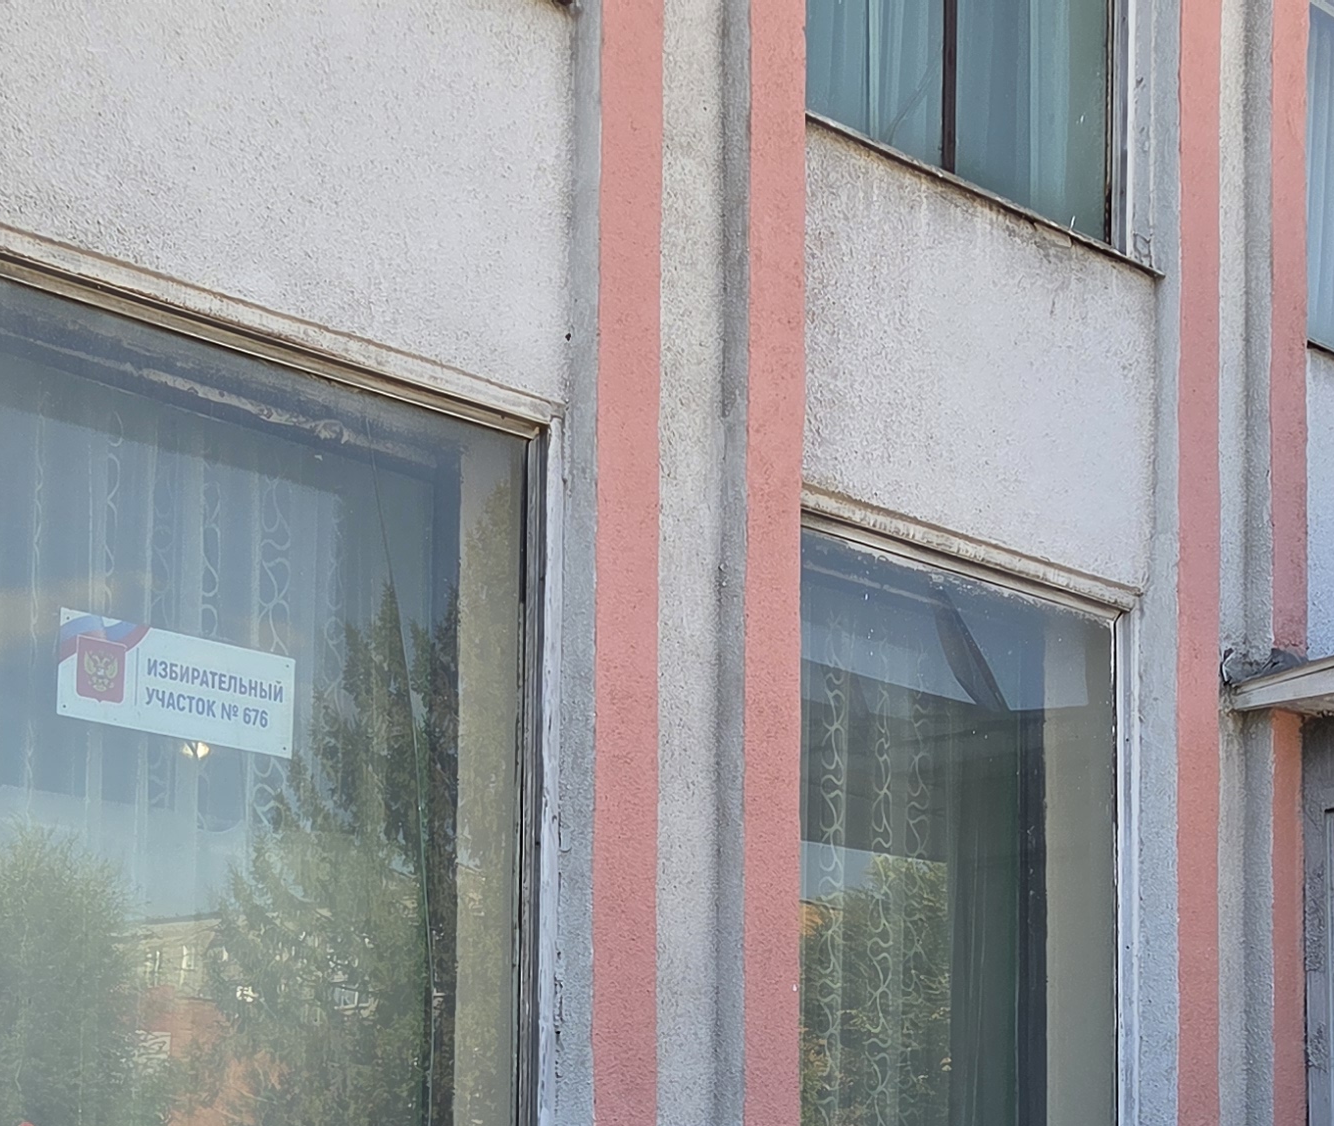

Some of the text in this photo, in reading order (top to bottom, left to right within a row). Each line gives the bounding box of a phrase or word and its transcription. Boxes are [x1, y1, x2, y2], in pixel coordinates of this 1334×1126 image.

[146, 658, 284, 703] ИЗБИРАТЕЛЬНЫЙ
[145, 686, 269, 728] УЧАСТОК № 676
